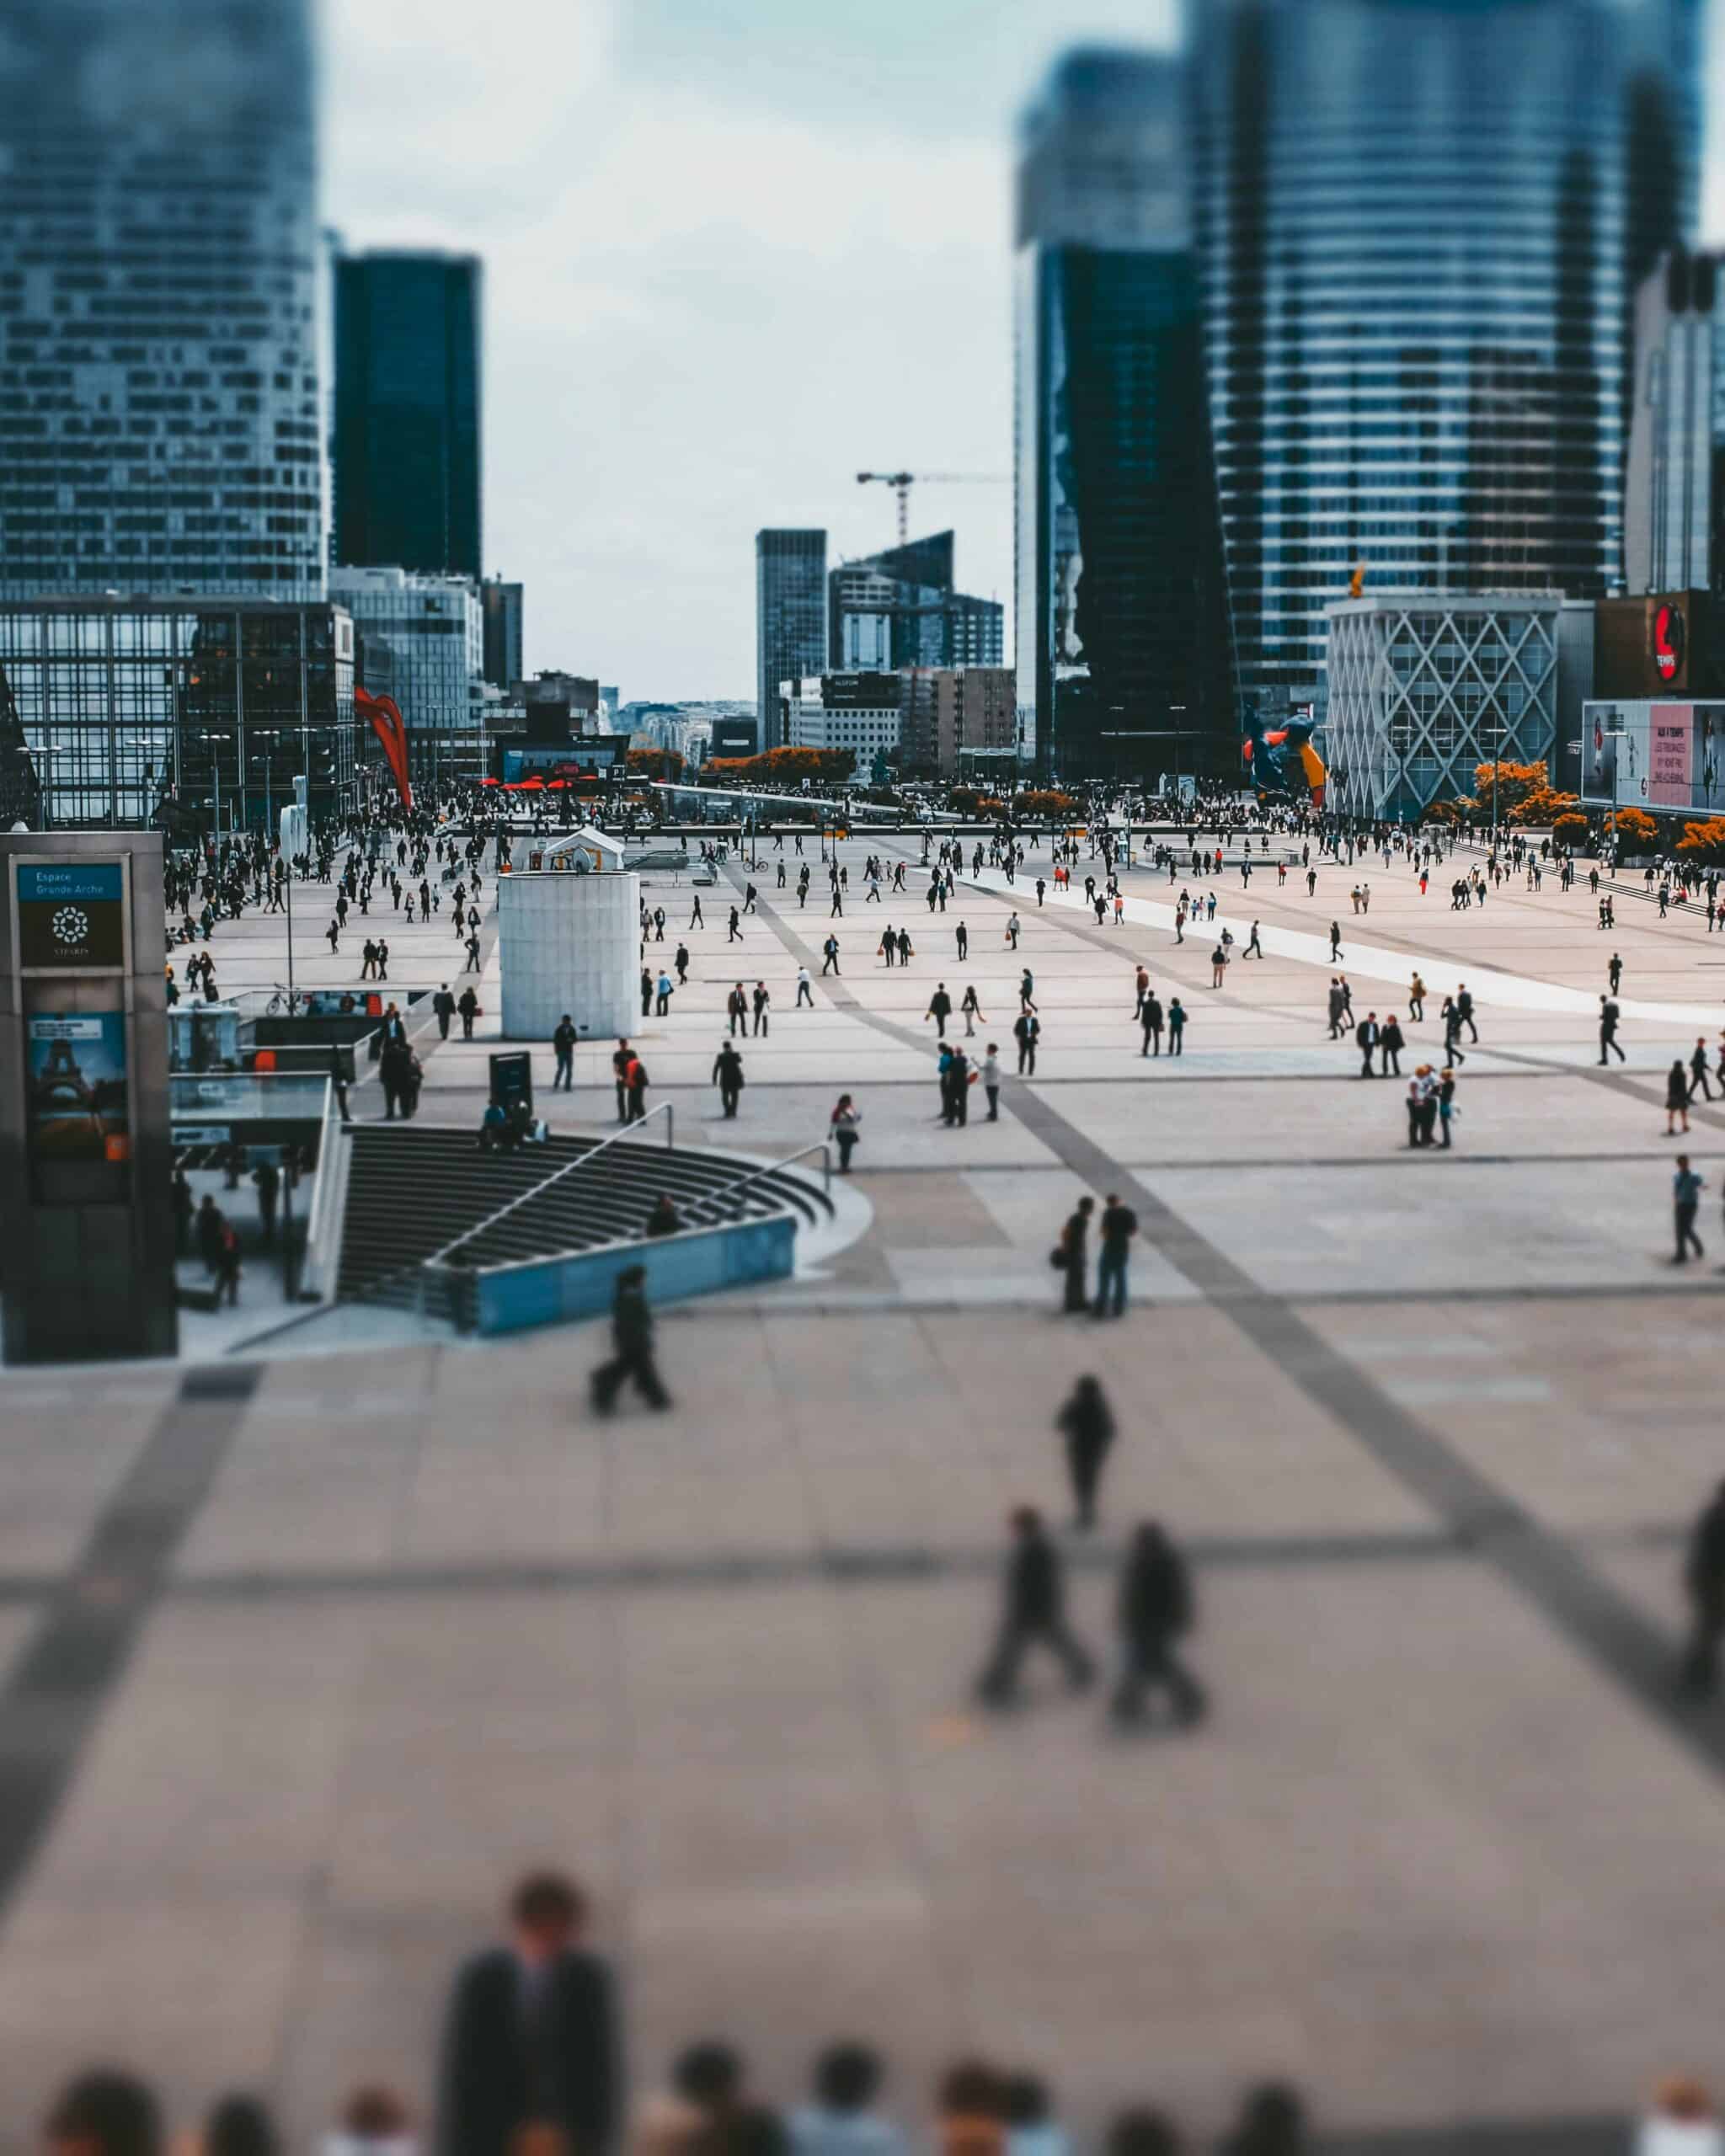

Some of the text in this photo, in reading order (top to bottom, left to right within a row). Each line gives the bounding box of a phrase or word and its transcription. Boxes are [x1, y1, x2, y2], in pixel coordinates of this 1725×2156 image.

[35, 872, 72, 883] Espace
[35, 885, 104, 895] Grande Arche
